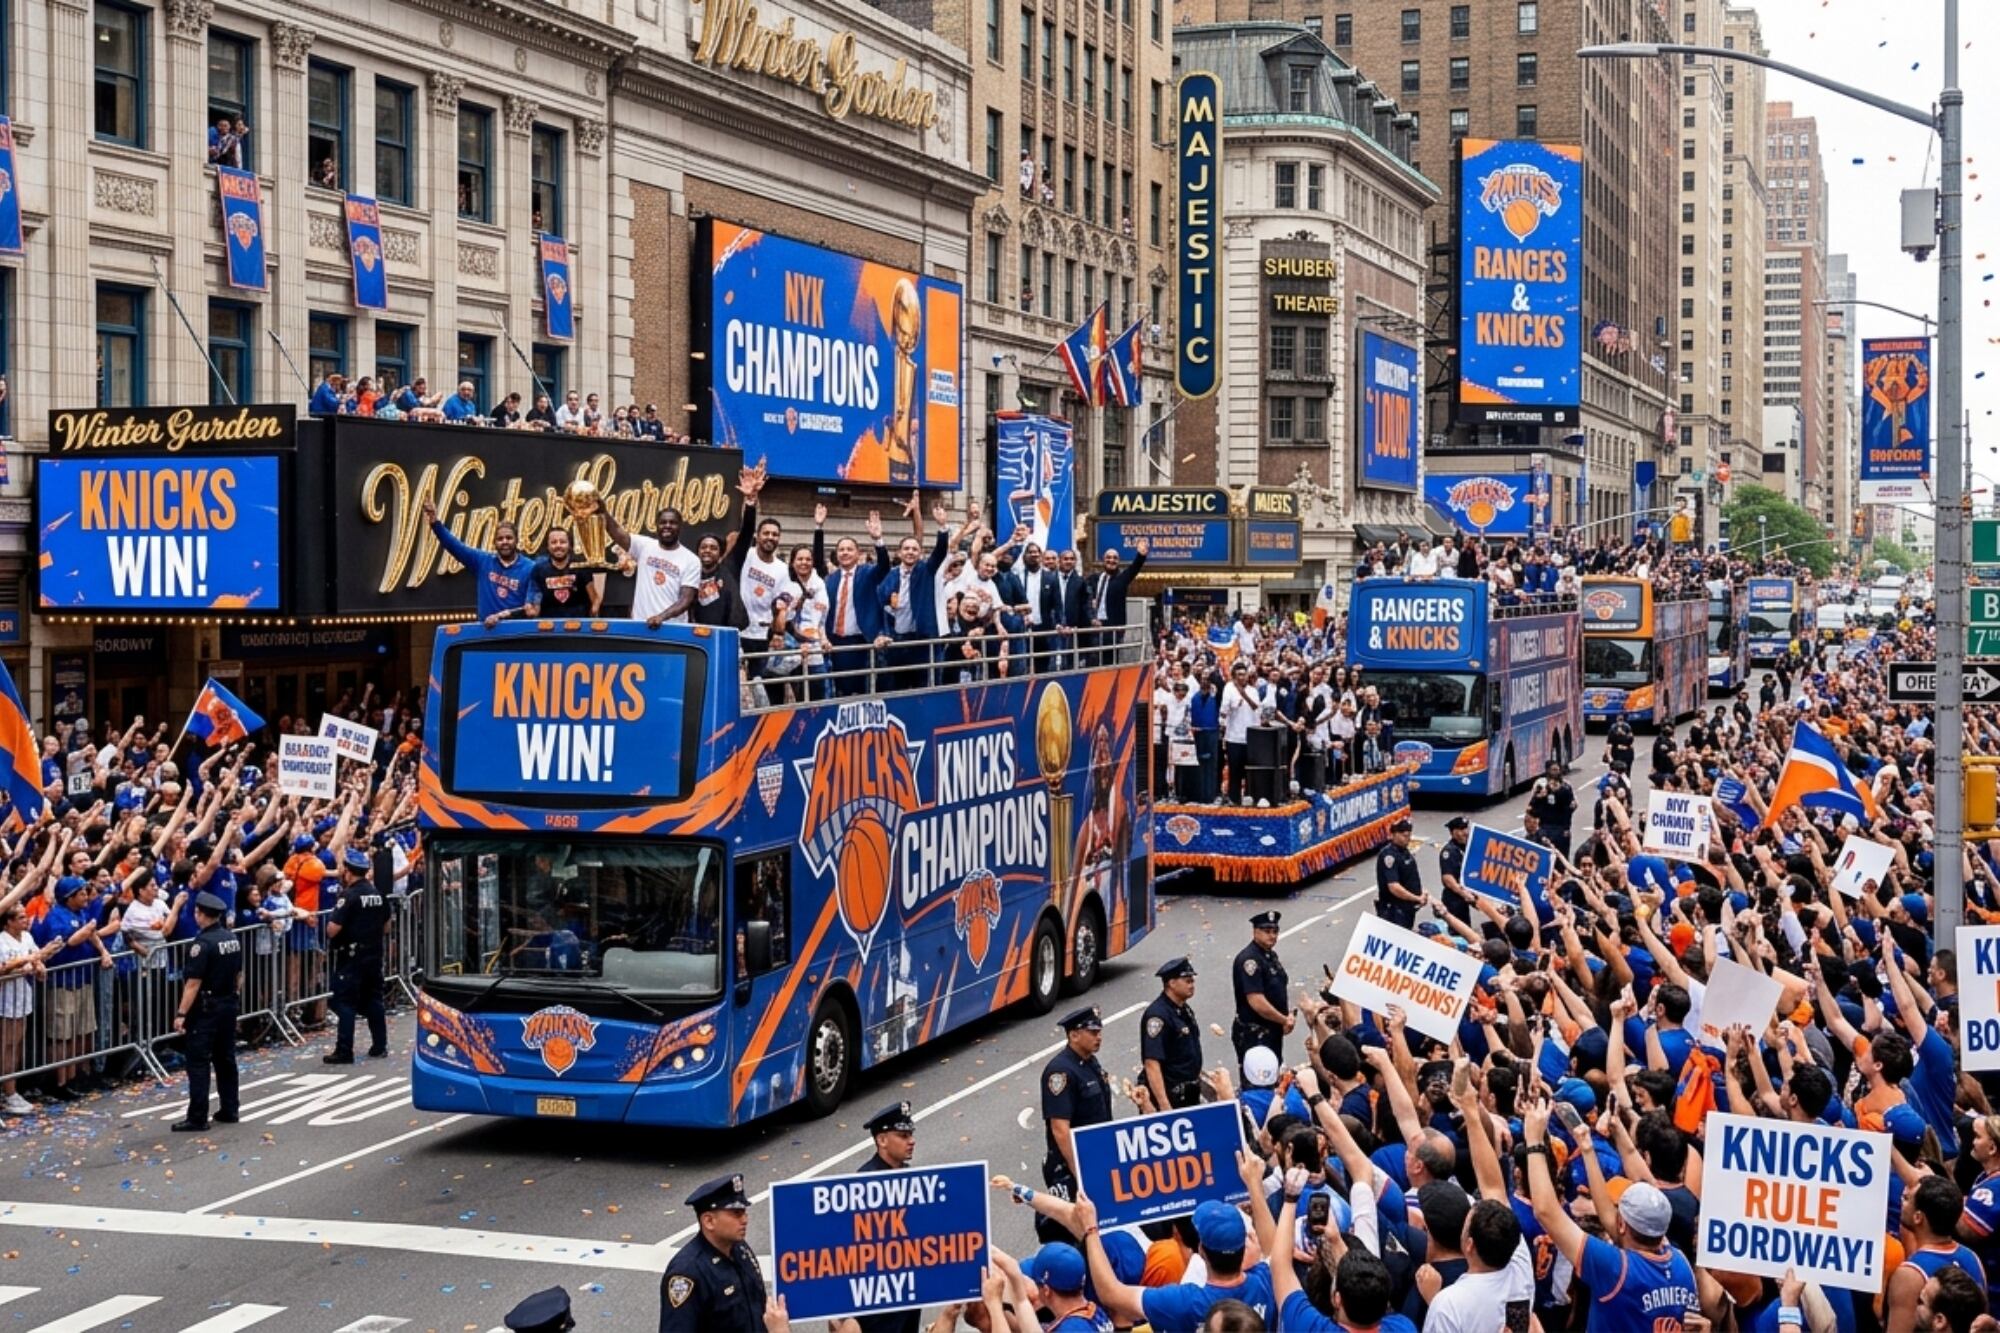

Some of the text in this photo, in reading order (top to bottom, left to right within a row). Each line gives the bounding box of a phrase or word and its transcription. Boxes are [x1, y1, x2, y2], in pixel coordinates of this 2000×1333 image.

[1183, 96, 1214, 364] MAJESTIC
[1474, 246, 1567, 283] RANGES
[784, 270, 825, 329] NYK
[1511, 283, 1530, 311] &
[1476, 312, 1565, 348] KNICKS
[725, 318, 879, 411] CHAMPIONS
[55, 408, 281, 451] Winter Garden
[81, 468, 236, 531] KNICKS
[1112, 494, 1216, 513] MAJESTIC
[107, 535, 208, 597] WIN!
[1371, 597, 1464, 624] RANGERS
[1369, 626, 1460, 651] & KNICKS
[493, 662, 646, 721] KNICKS
[517, 723, 615, 783] WIN!
[937, 731, 1015, 806] KNICKS
[803, 720, 920, 843] KNICKS
[902, 790, 1047, 911] CHAMPIONS
[1481, 860, 1522, 893] WIN
[1363, 934, 1461, 991] NY WE ARE
[1975, 937, 2000, 975] K
[1115, 1118, 1197, 1163] MSG
[1722, 1125, 1874, 1187] KNICKS
[813, 1175, 946, 1215] BORDWAY:
[1111, 1152, 1215, 1202] LOUD!
[854, 1208, 908, 1242] NYK
[1745, 1178, 1841, 1229] RULE
[780, 1232, 984, 1283] CHAMPIONSHIP
[1707, 1218, 1873, 1277] BORDWAY!
[850, 1273, 916, 1308] WAY!
